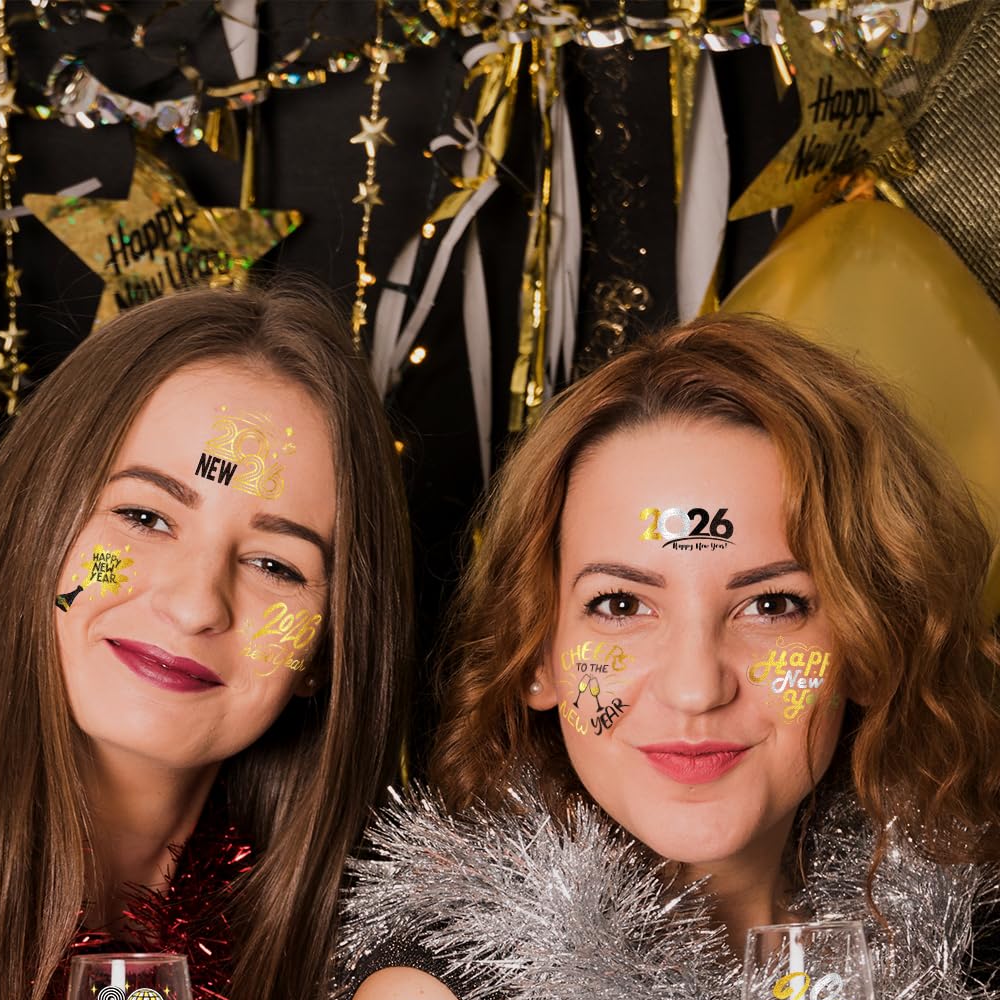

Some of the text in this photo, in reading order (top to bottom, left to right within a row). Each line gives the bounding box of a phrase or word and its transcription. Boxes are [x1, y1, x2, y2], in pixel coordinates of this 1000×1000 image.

[809, 75, 884, 137] Happy
[105, 200, 196, 276] Happy
[204, 418, 270, 468] 20
[195, 453, 285, 500] NEW 26
[638, 507, 735, 541] 2026
[89, 571, 118, 584] YEAR
[92, 562, 116, 573] NEW
[93, 553, 121, 568] HAPPY
[576, 662, 609, 674] TO THE
[771, 669, 825, 694] New
[590, 697, 631, 736] YEAR
